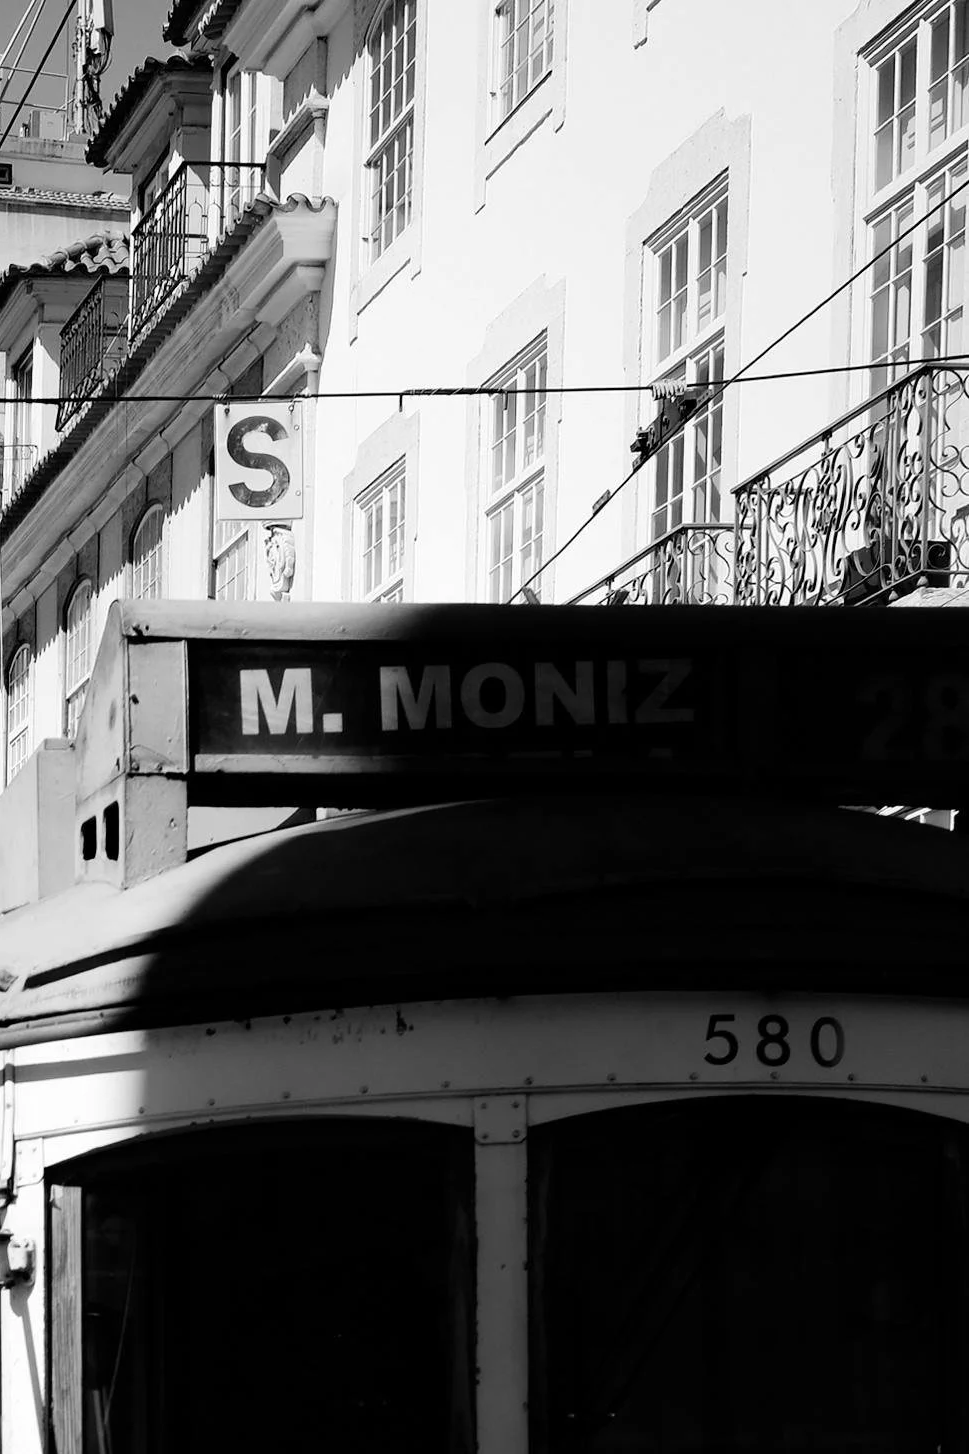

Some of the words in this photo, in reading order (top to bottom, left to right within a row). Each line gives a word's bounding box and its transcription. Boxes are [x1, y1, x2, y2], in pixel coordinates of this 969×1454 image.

[227, 415, 290, 508] S
[240, 666, 342, 736] M.
[379, 657, 695, 732] MONIZ
[704, 1013, 847, 1069] 580
